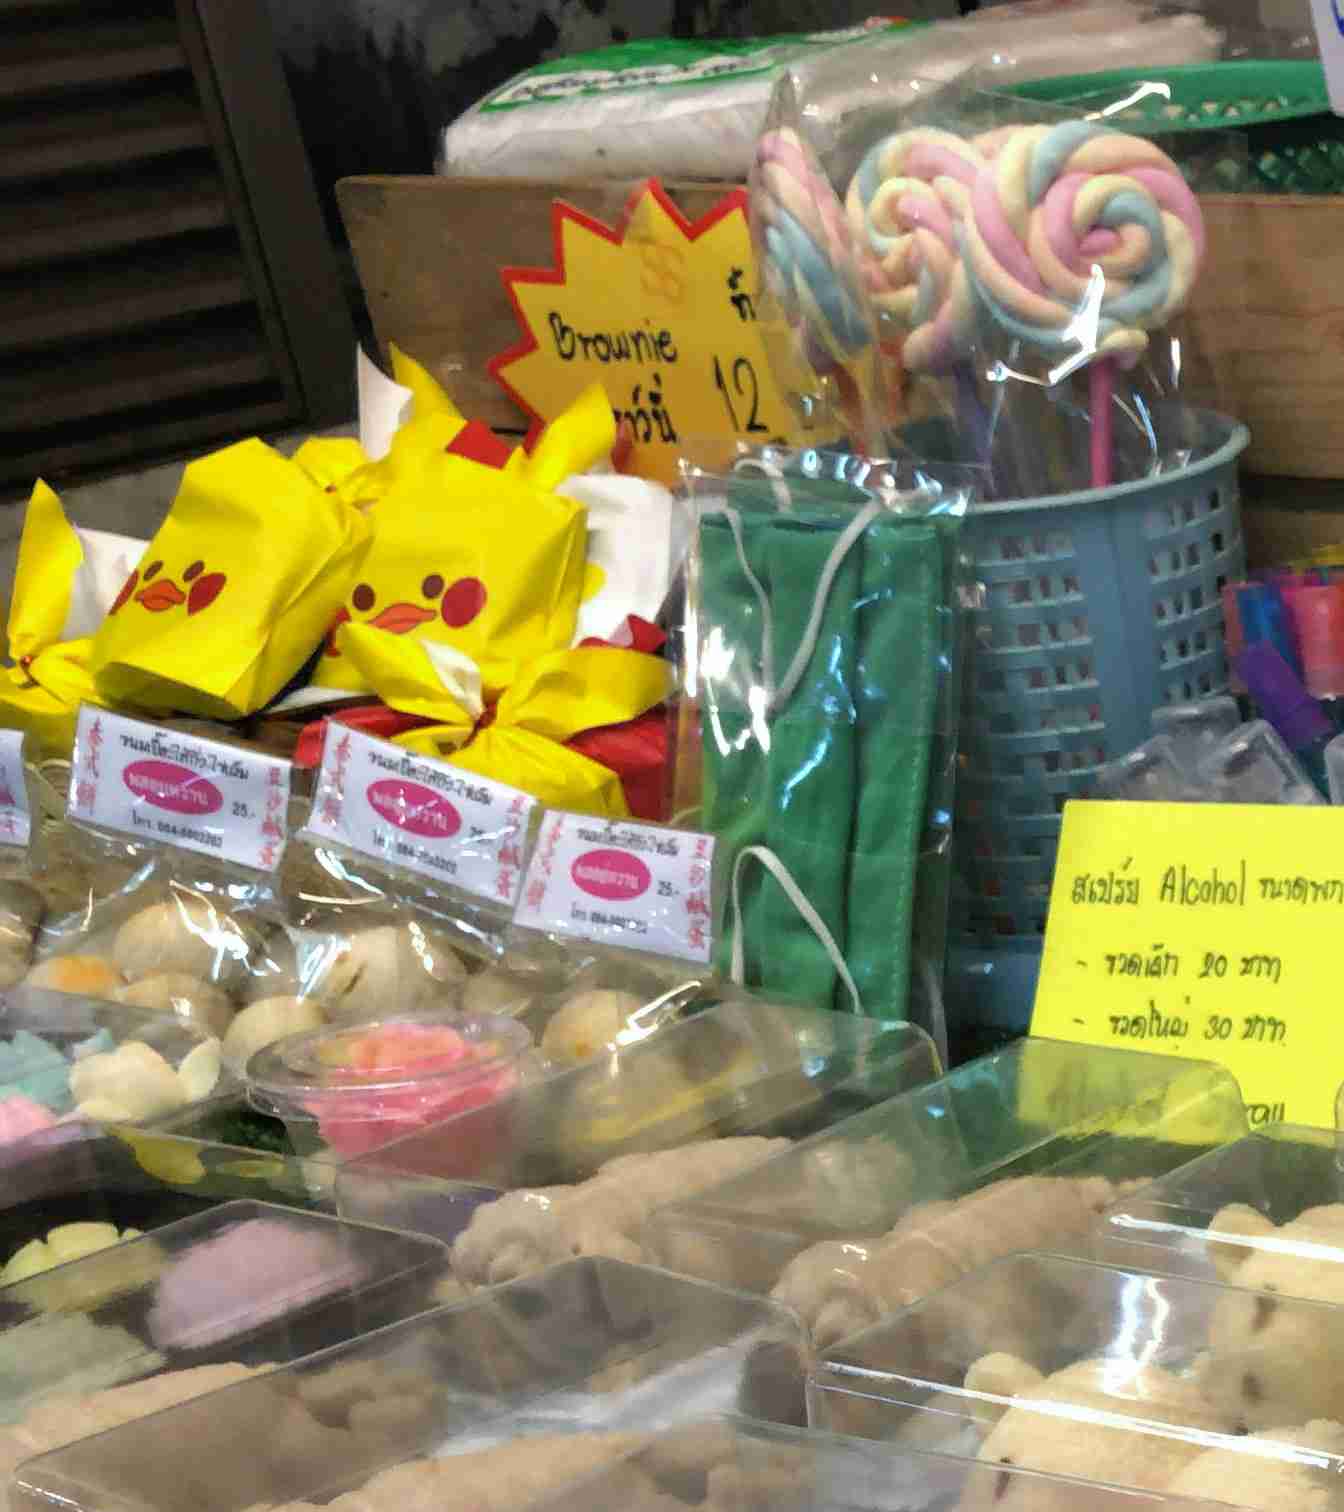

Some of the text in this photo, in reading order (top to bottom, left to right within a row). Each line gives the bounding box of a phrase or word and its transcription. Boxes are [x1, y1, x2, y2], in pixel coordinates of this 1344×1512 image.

[1159, 859, 1246, 905] Alcohol
[1199, 951, 1228, 979] 20
[1203, 1015, 1232, 1041] 30
